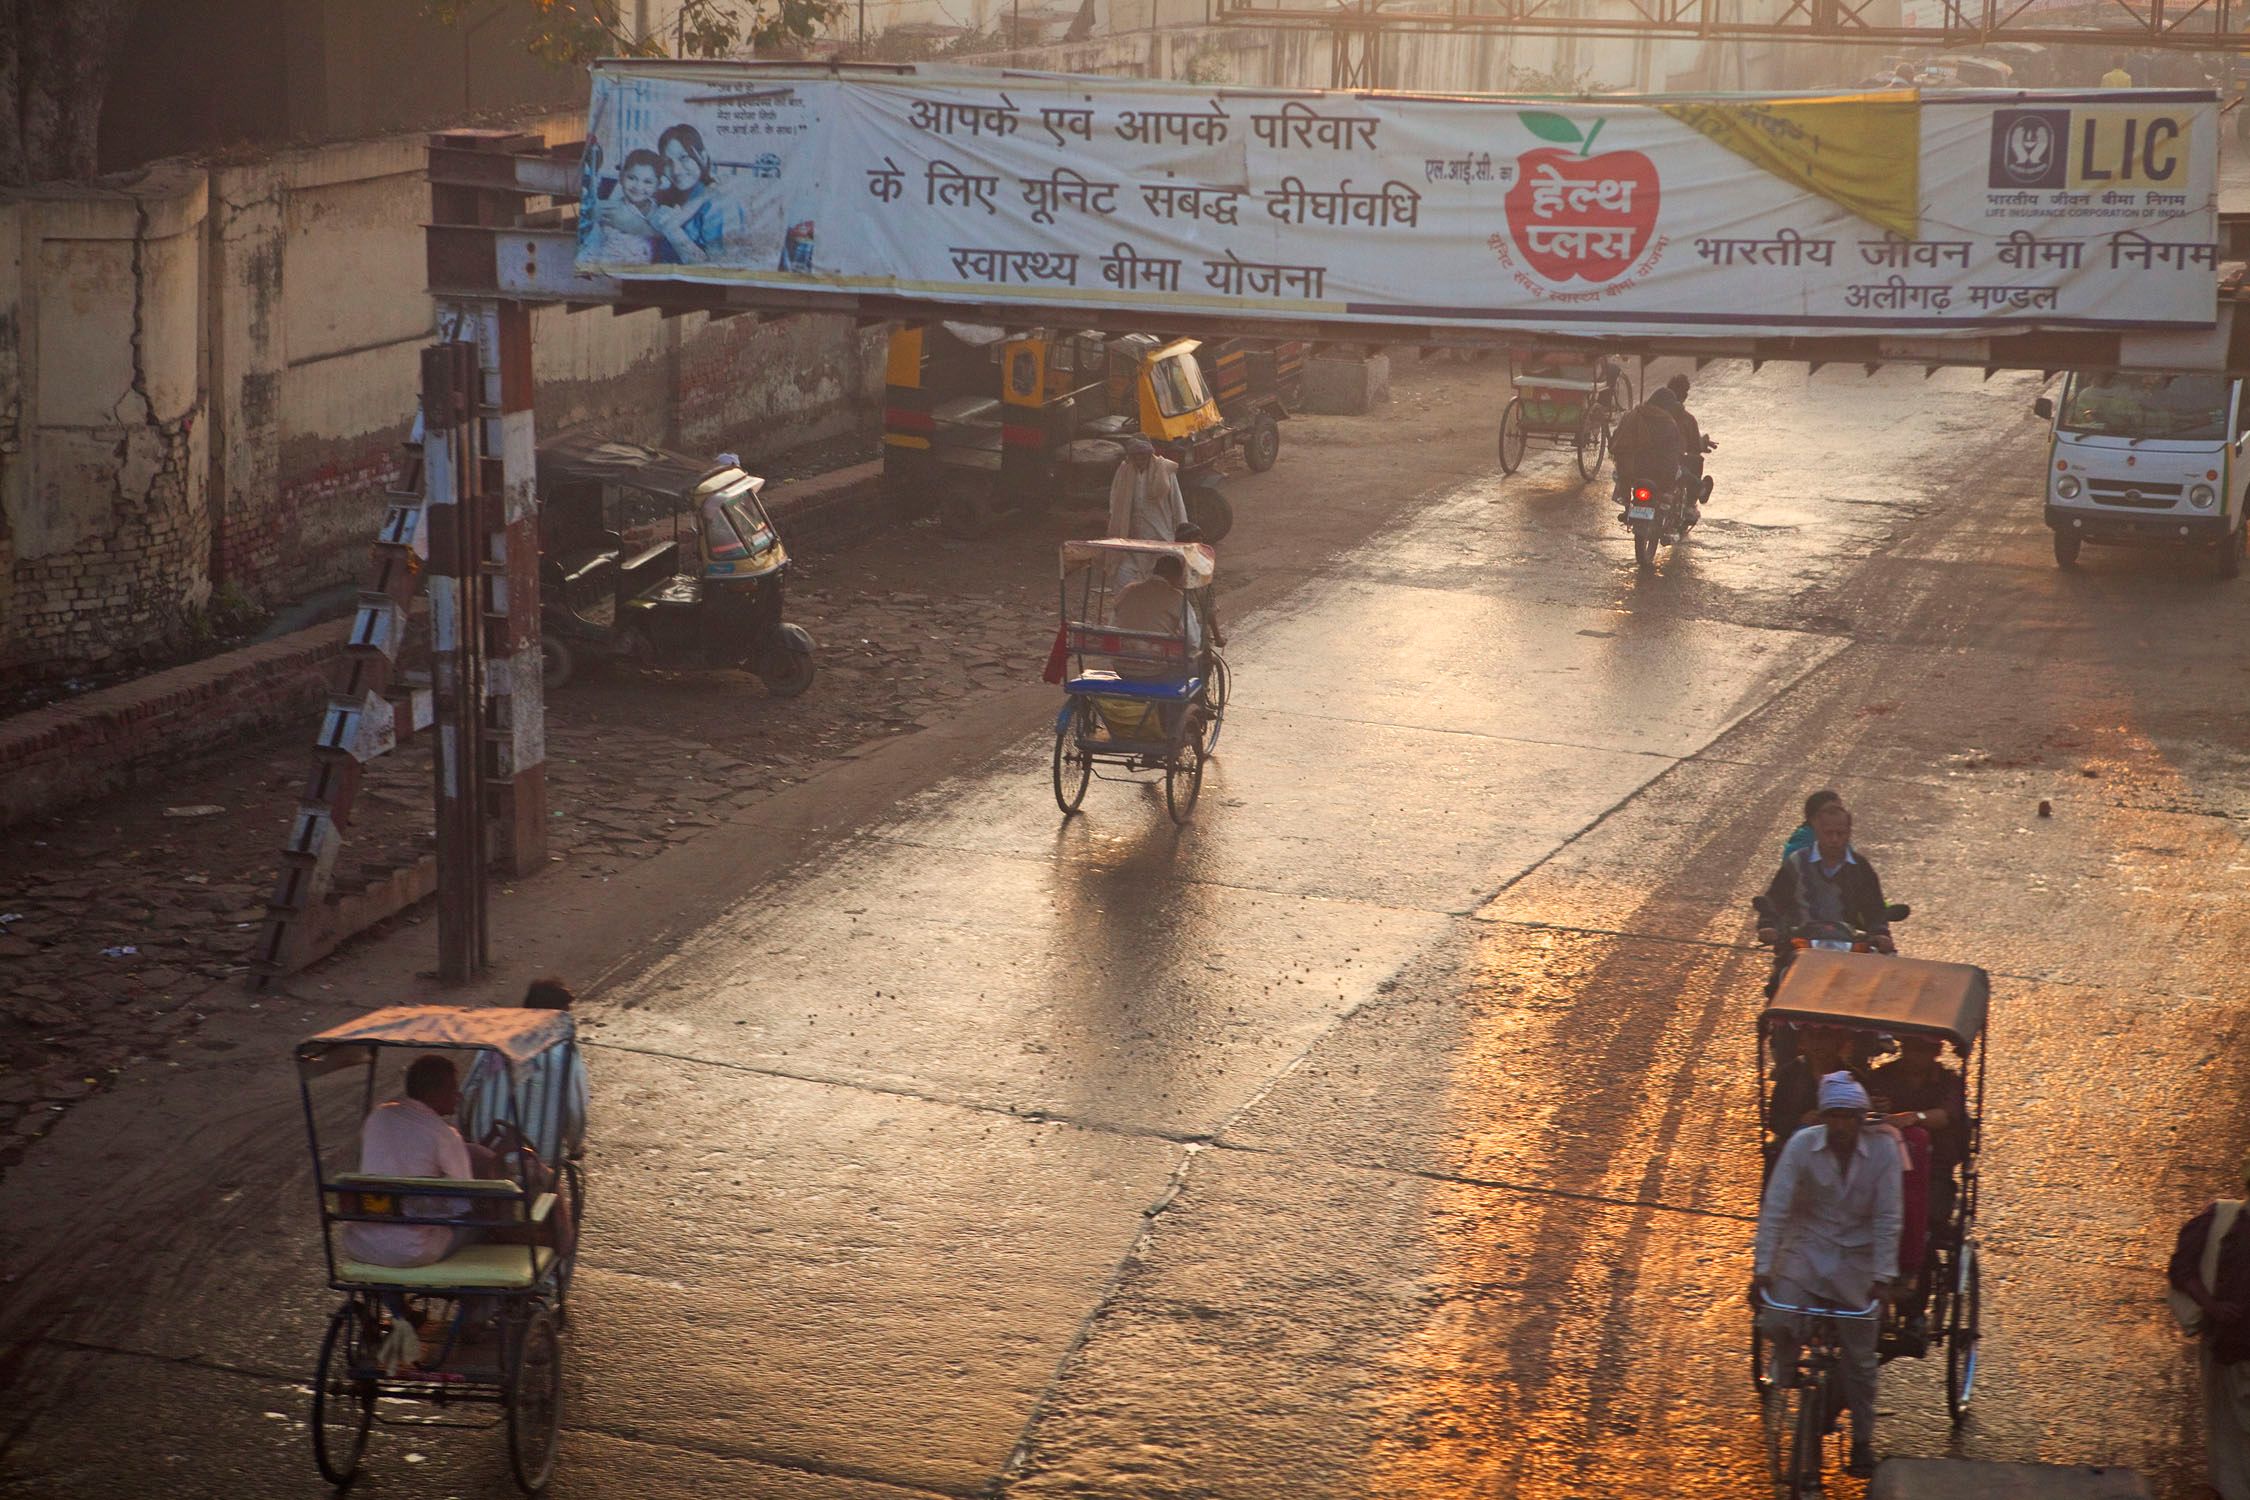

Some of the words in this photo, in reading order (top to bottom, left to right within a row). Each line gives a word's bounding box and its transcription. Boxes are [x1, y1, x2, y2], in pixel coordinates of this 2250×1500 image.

[908, 93, 1020, 137] आपके
[1040, 95, 1094, 147] एवं
[1115, 100, 1230, 145] आपके
[1250, 102, 1381, 150] परिवार
[1425, 152, 1494, 185] एल.आई.सी.
[1500, 167, 1513, 181] का
[2081, 117, 2179, 181] LIC
[867, 157, 905, 203] के
[925, 160, 999, 215] लिए
[1019, 167, 1120, 225] यूनिट
[1140, 171, 1240, 226] संबद्ध
[1264, 176, 1422, 228] दीर्घावधि
[1530, 164, 1637, 218] हेल्थ
[1985, 208, 2006, 217] LIFE
[2008, 208, 2065, 217] INSURANCE
[2067, 208, 2139, 217] CORPORATION
[2142, 208, 2155, 217] OF
[1987, 191, 2039, 205] भारतीय
[2050, 191, 2090, 205] जीवन
[2101, 191, 2135, 205] बीमा
[2146, 191, 2186, 205] निगम
[1526, 225, 1637, 260] प्लस
[1694, 227, 1836, 267] भारतीय
[1858, 230, 1973, 268] जीवन
[1996, 230, 2085, 269] बीमा
[2109, 230, 2218, 270] निगम
[950, 247, 1079, 286] स्वास्थ्य
[1099, 242, 1182, 292] बीमा
[1203, 249, 1327, 299] योजना
[1845, 274, 1952, 315] अलीगढ़
[1968, 285, 2059, 310] मण्डल
